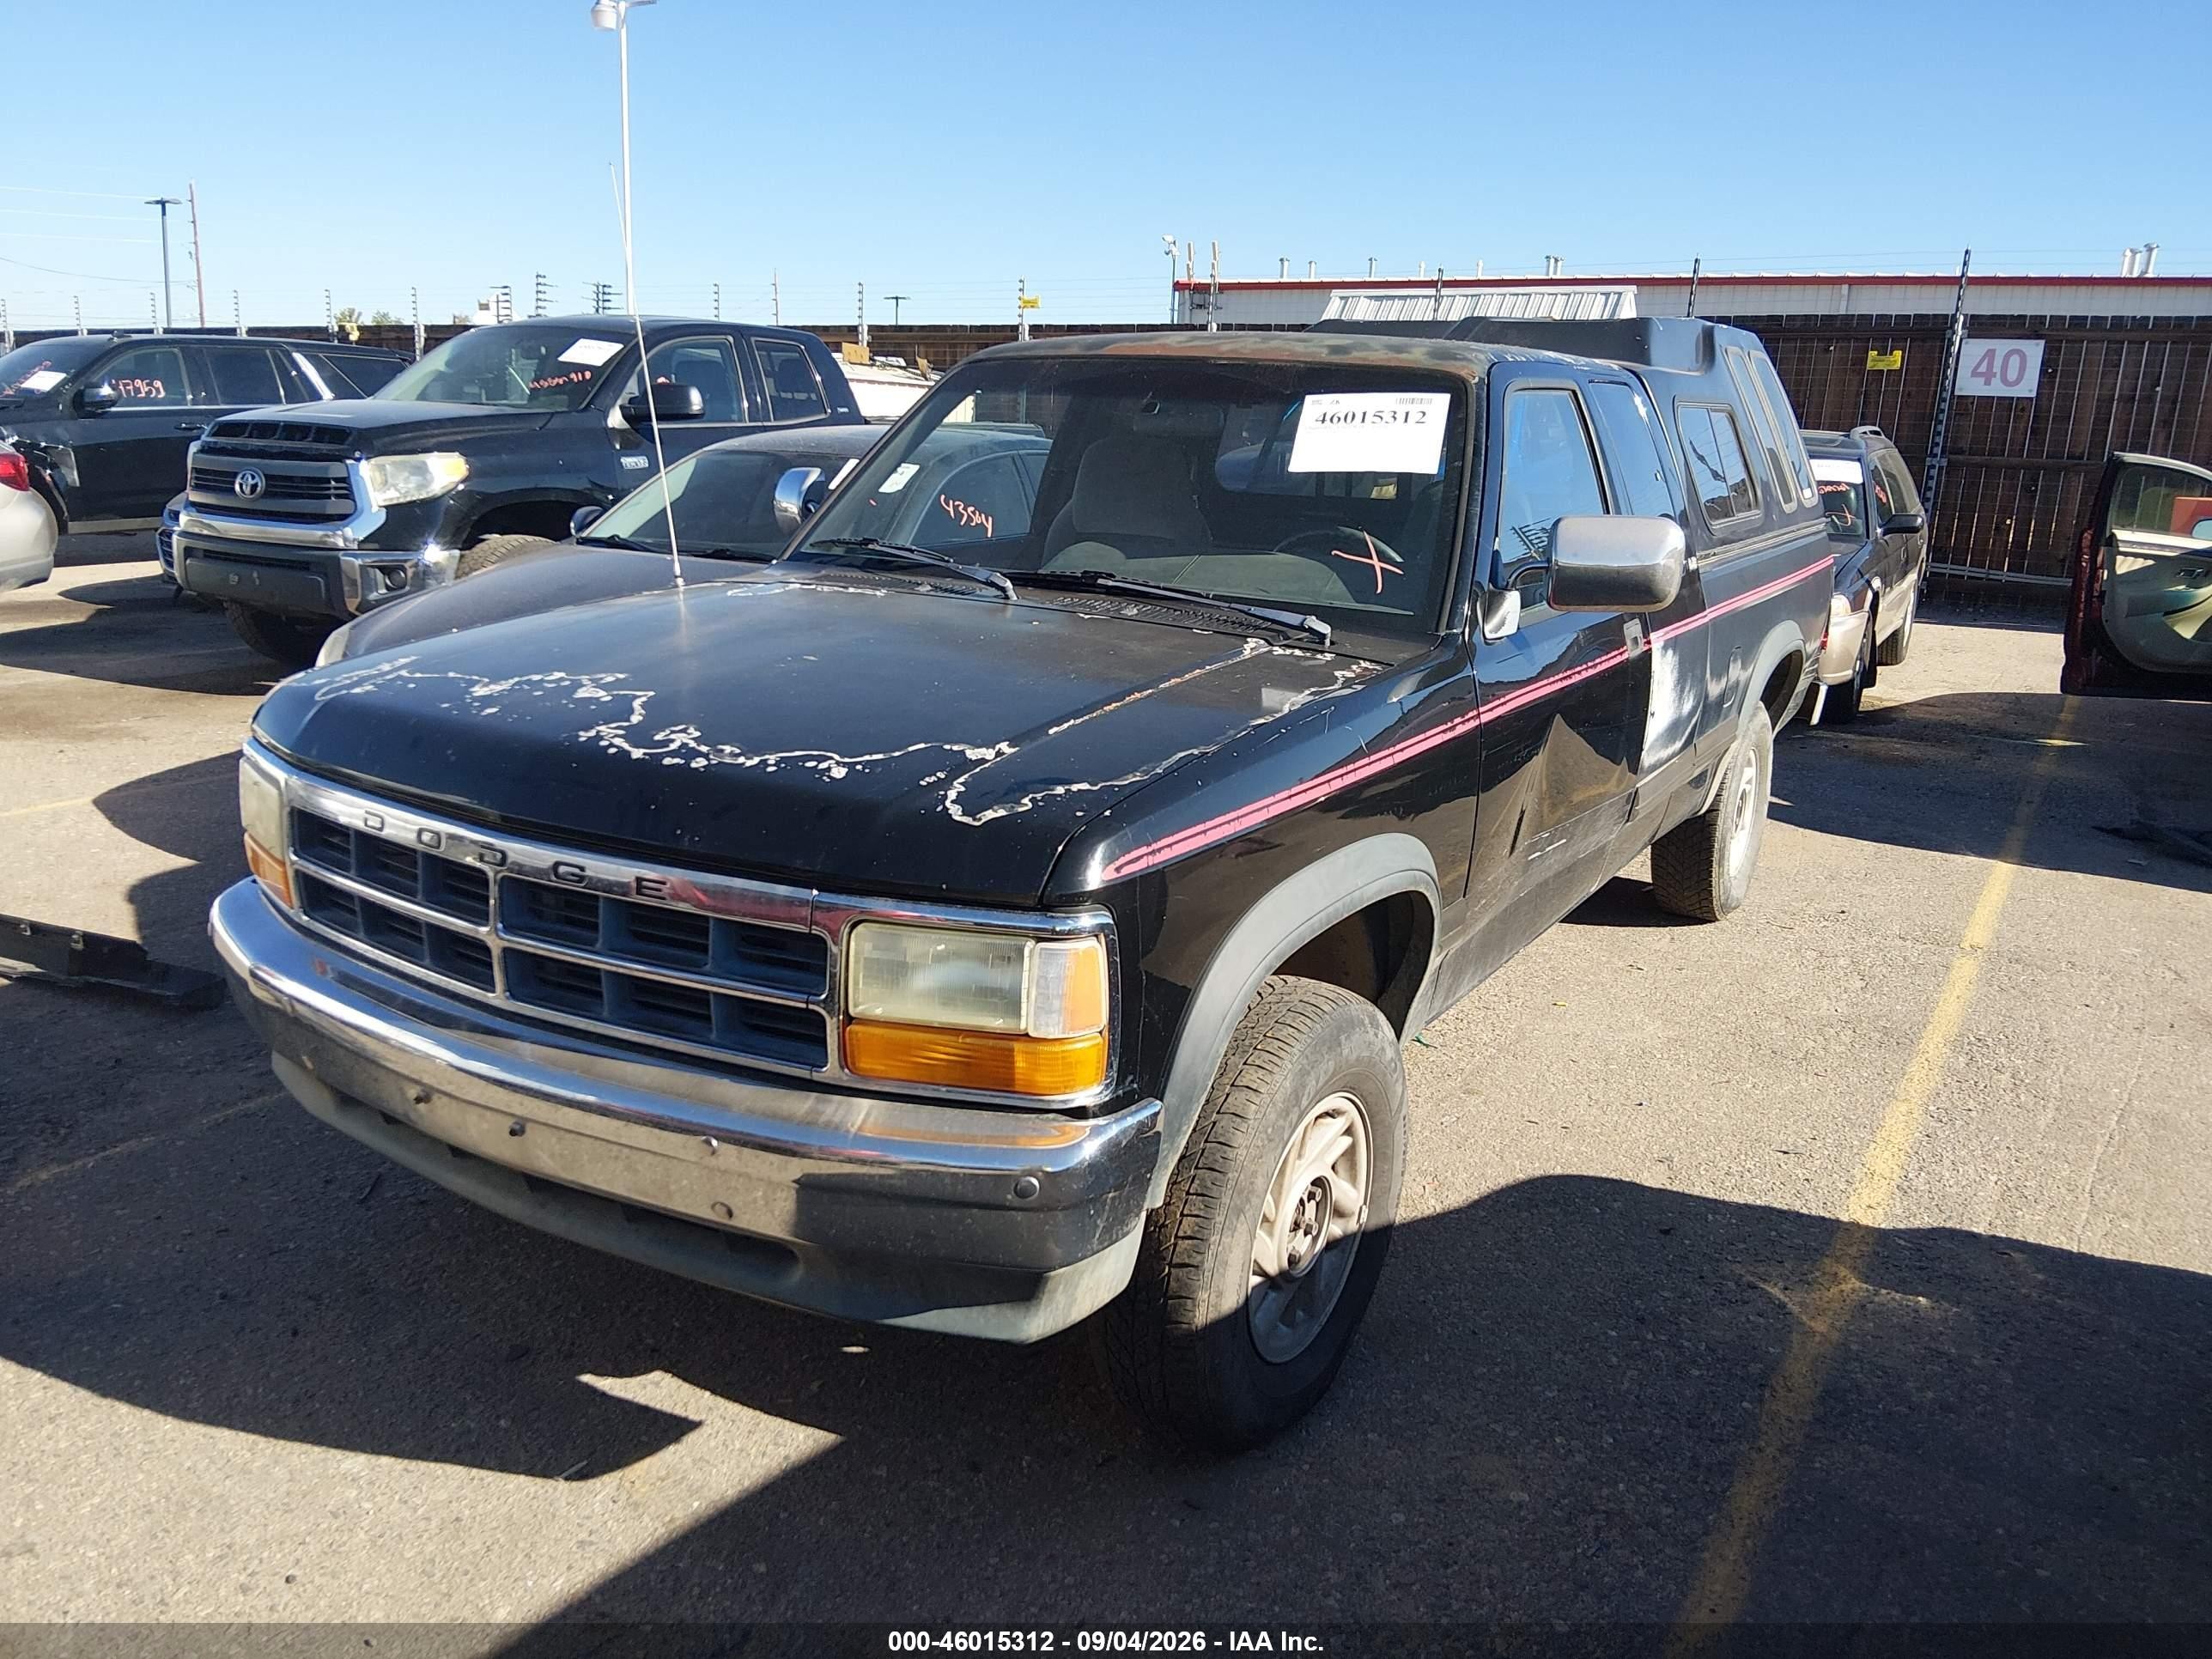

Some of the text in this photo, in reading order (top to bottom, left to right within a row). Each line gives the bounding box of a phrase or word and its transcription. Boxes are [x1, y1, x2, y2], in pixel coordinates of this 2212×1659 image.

[1970, 348, 2027, 388] 40
[1315, 410, 1427, 425] 46015312
[363, 809, 669, 902] DODGE
